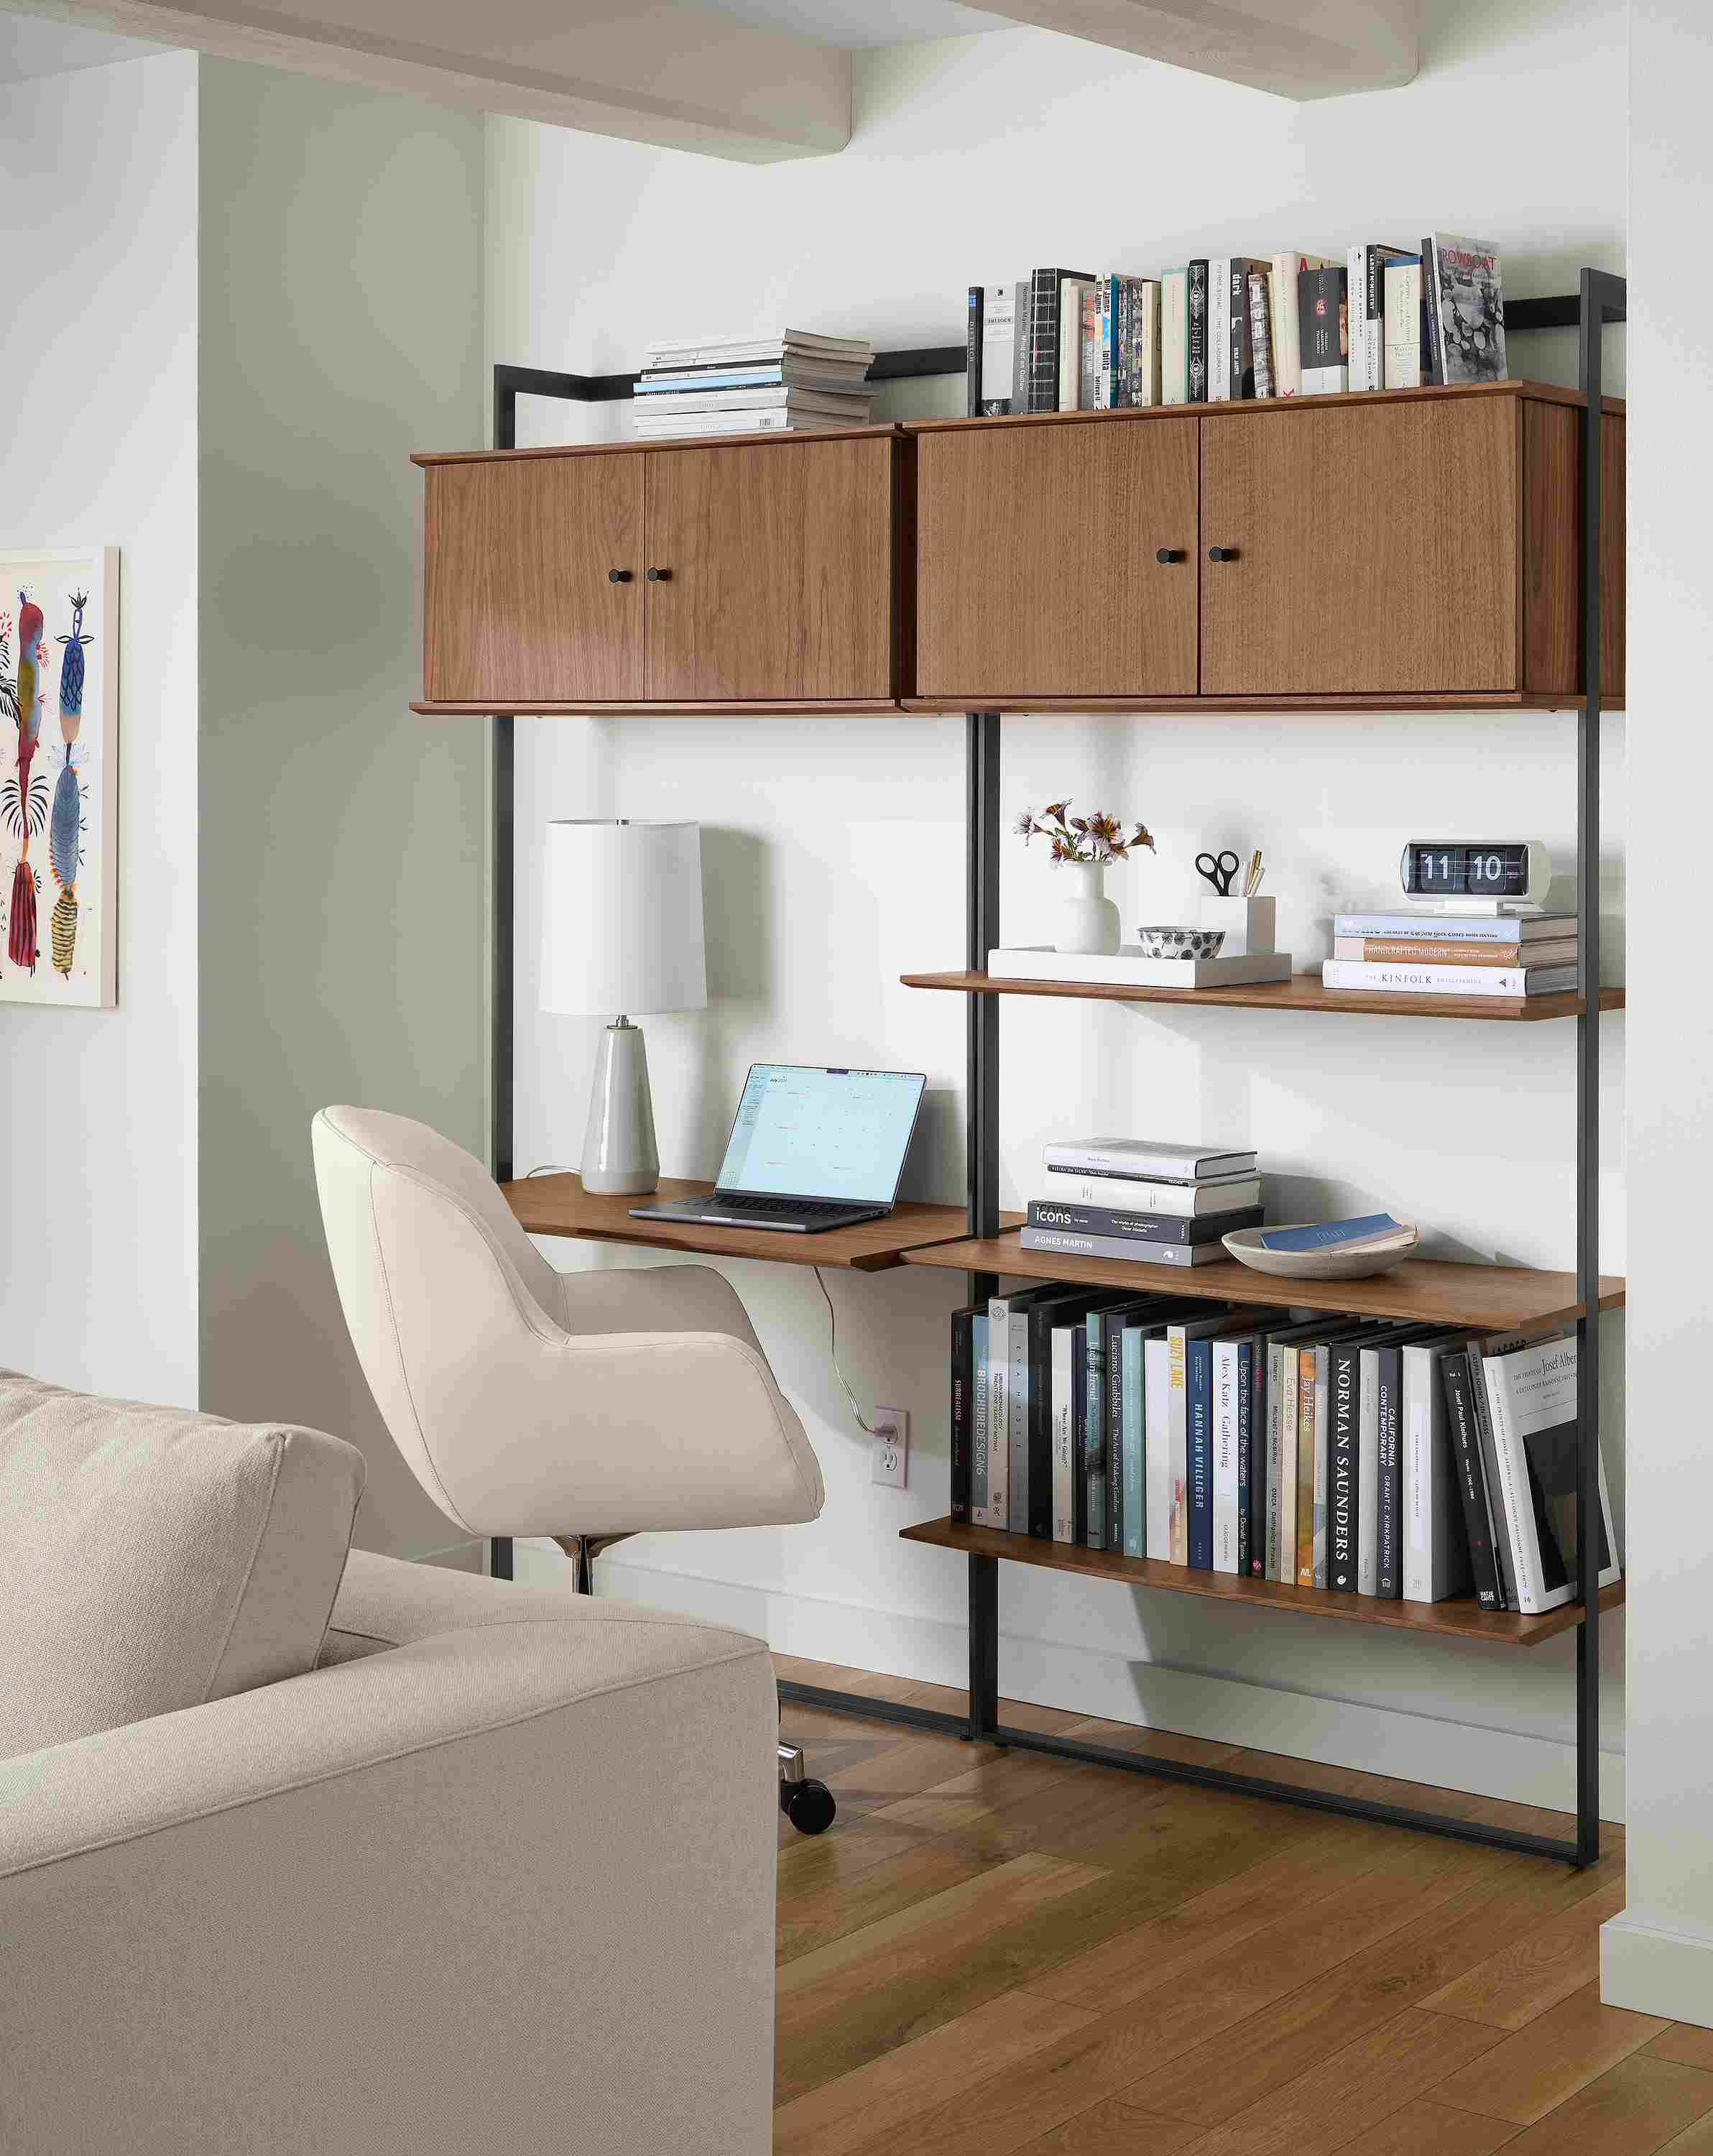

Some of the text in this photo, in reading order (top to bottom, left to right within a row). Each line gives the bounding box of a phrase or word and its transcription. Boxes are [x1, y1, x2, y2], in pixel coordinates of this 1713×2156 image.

[1442, 248, 1496, 271] ROWBOAT
[1232, 273, 1242, 296] dark
[1102, 350, 1111, 371] lolita
[1425, 855, 1448, 880] 11
[1473, 855, 1501, 880] 10
[1367, 944, 1416, 955] HANDCRAFTED
[1417, 947, 1448, 957] MODERN
[1381, 973, 1432, 984] KINFOLK
[1035, 1207, 1071, 1225] icons
[1034, 1235, 1093, 1249] AGNES MARTIN
[1088, 1341, 1099, 1372] Lucian
[1169, 1335, 1185, 1389] SUZY LAKE
[1541, 1355, 1559, 1376] Josef
[1088, 1372, 1099, 1402] Freud
[1110, 1333, 1121, 1419] Luciano Giubbilei
[1220, 1356, 1232, 1408] Alex Katz
[1301, 1375, 1314, 1432] Jay Heikes
[1237, 1360, 1250, 1488] Upon the face of the waters
[1459, 1422, 1468, 1449] Kleihues
[1218, 1414, 1232, 1469] Gathering
[1388, 1408, 1396, 1467] CALIFORNIA
[1194, 1403, 1204, 1509] HANNAH VILLIGER
[1335, 1359, 1351, 1561] NORMAN SAUNDERS
[1110, 1461, 1119, 1486] Making
[1383, 1504, 1390, 1513] C.
[1239, 1516, 1247, 1539] Donald
[1238, 1539, 1247, 1560] Tipton
[1382, 1514, 1391, 1569] KIRKPATRICK
